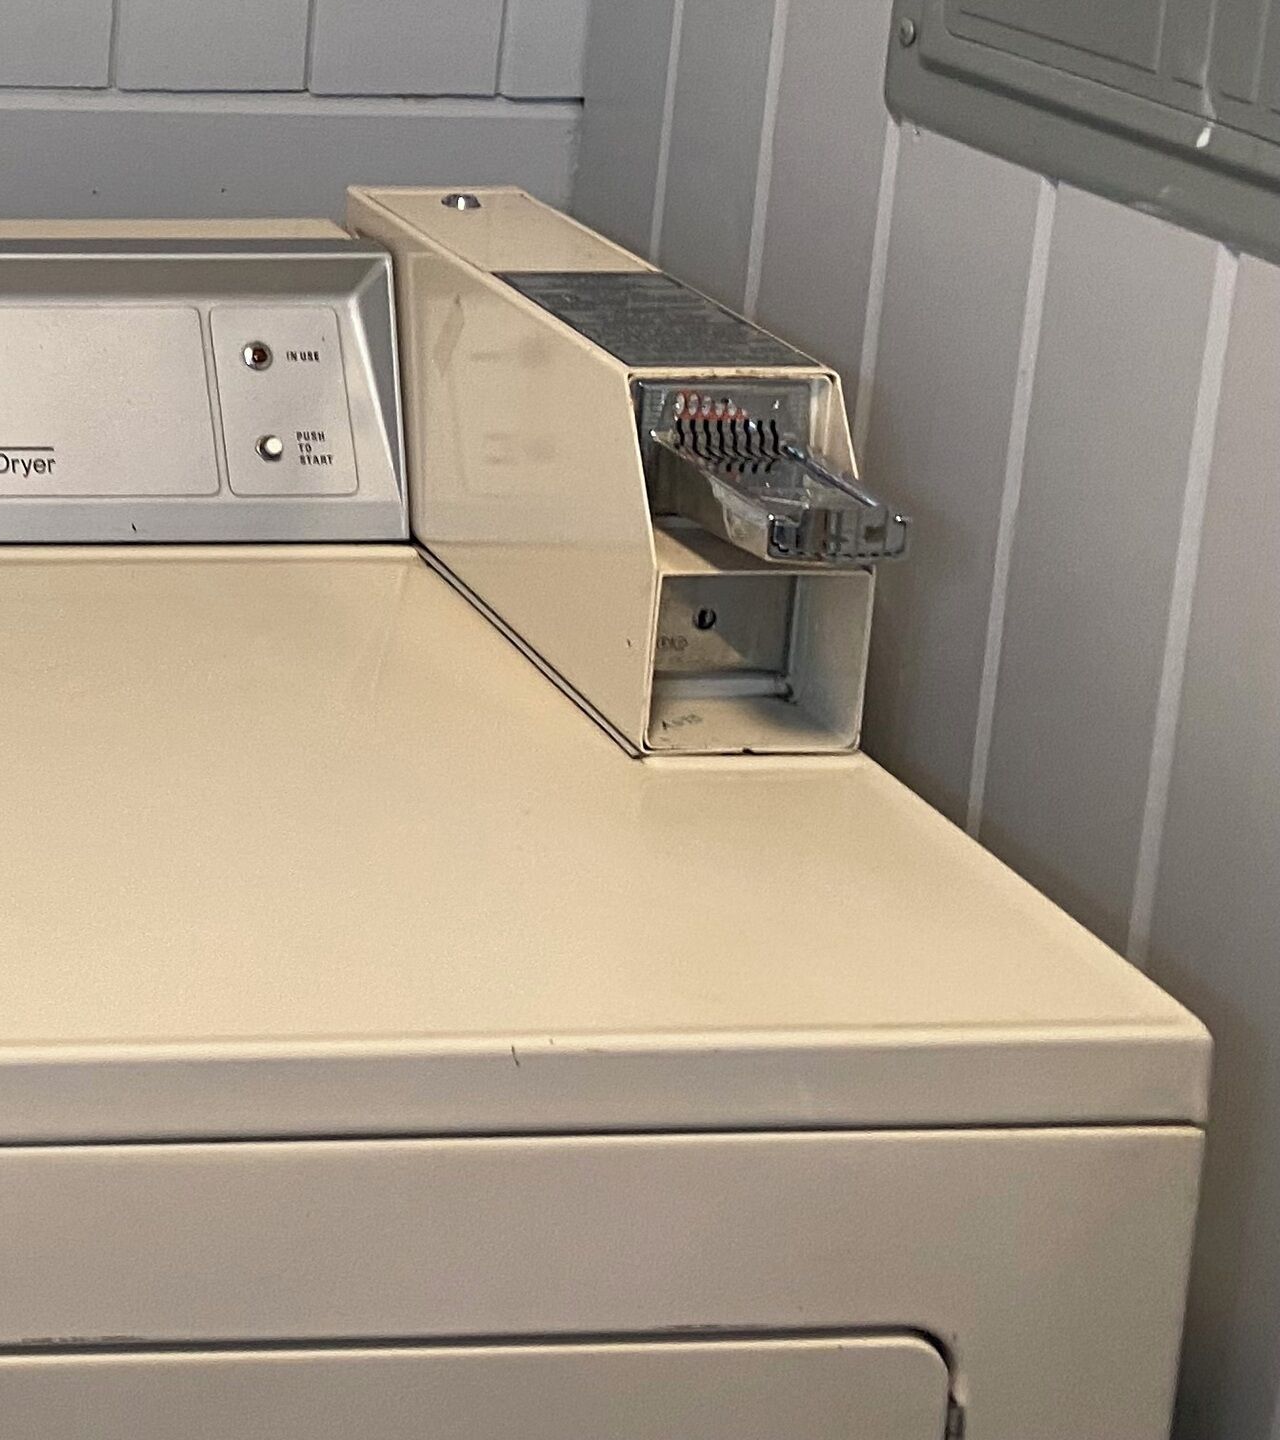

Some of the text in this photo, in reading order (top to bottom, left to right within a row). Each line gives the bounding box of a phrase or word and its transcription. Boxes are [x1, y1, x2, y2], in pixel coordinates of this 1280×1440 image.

[287, 351, 320, 362] IN USE
[297, 432, 325, 442] PUSH
[299, 443, 312, 453] TO
[300, 455, 333, 465] START
